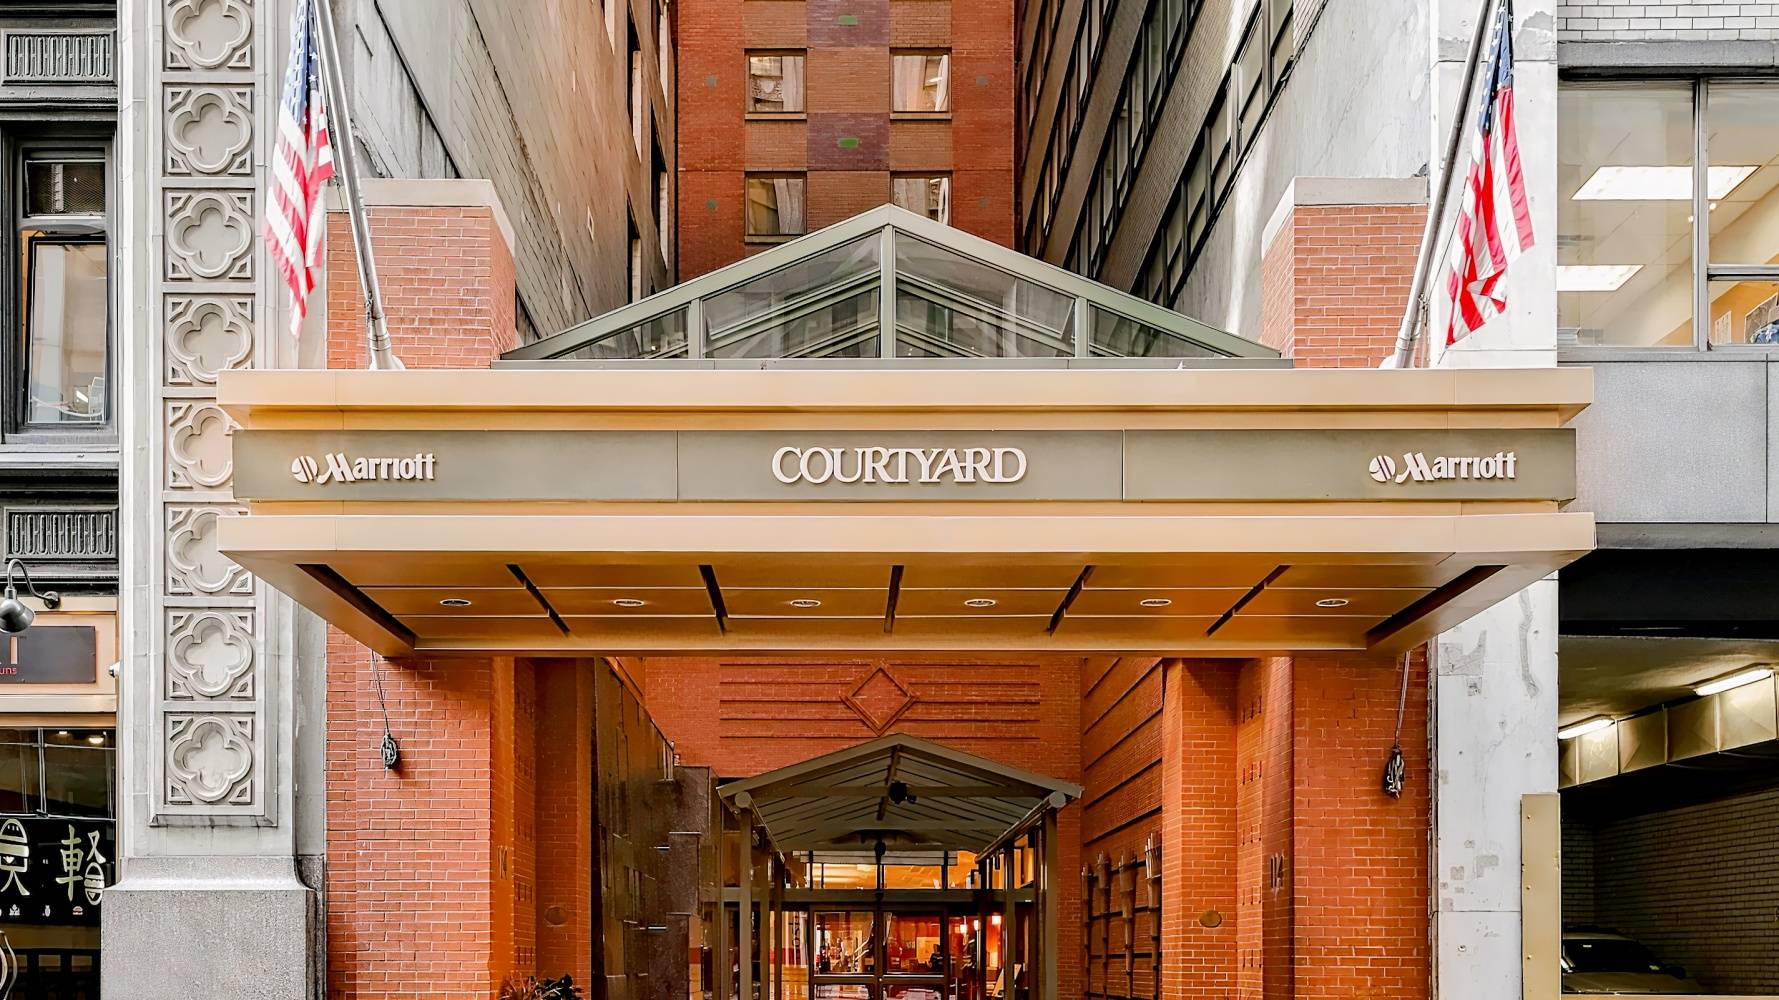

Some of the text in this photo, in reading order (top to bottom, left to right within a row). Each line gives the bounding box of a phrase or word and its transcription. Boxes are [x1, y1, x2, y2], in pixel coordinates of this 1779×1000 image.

[316, 452, 436, 485] Marriott
[771, 446, 1028, 484] COURTYARD
[1394, 451, 1517, 484] Marriott
